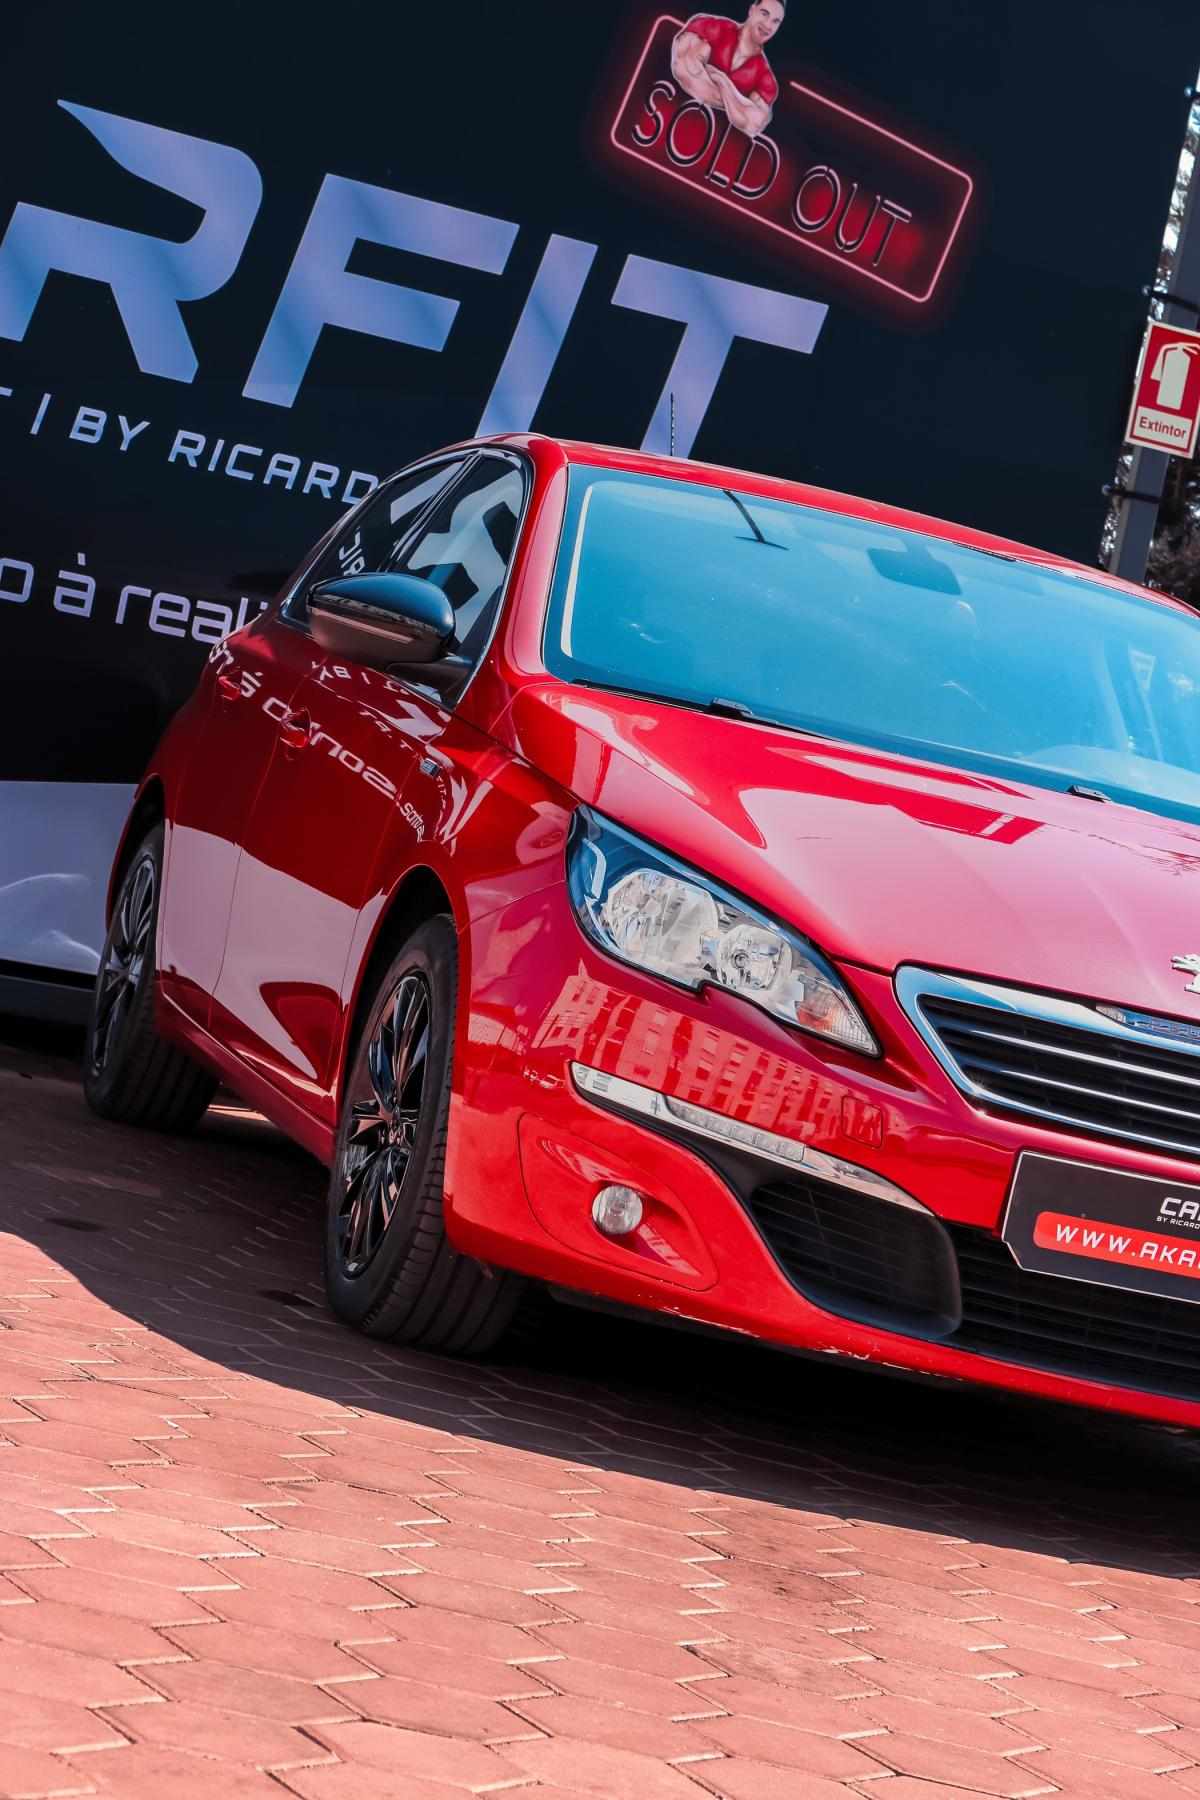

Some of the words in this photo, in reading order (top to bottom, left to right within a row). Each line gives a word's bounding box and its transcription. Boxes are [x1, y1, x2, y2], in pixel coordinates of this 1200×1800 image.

[631, 79, 780, 200] SOLD
[791, 164, 913, 267] OUT
[69, 405, 151, 451] BY
[1138, 416, 1187, 438] Extintor
[115, 584, 268, 645] real
[1160, 1196, 1200, 1221] CA
[1056, 1223, 1200, 1269] WWW.AKA
